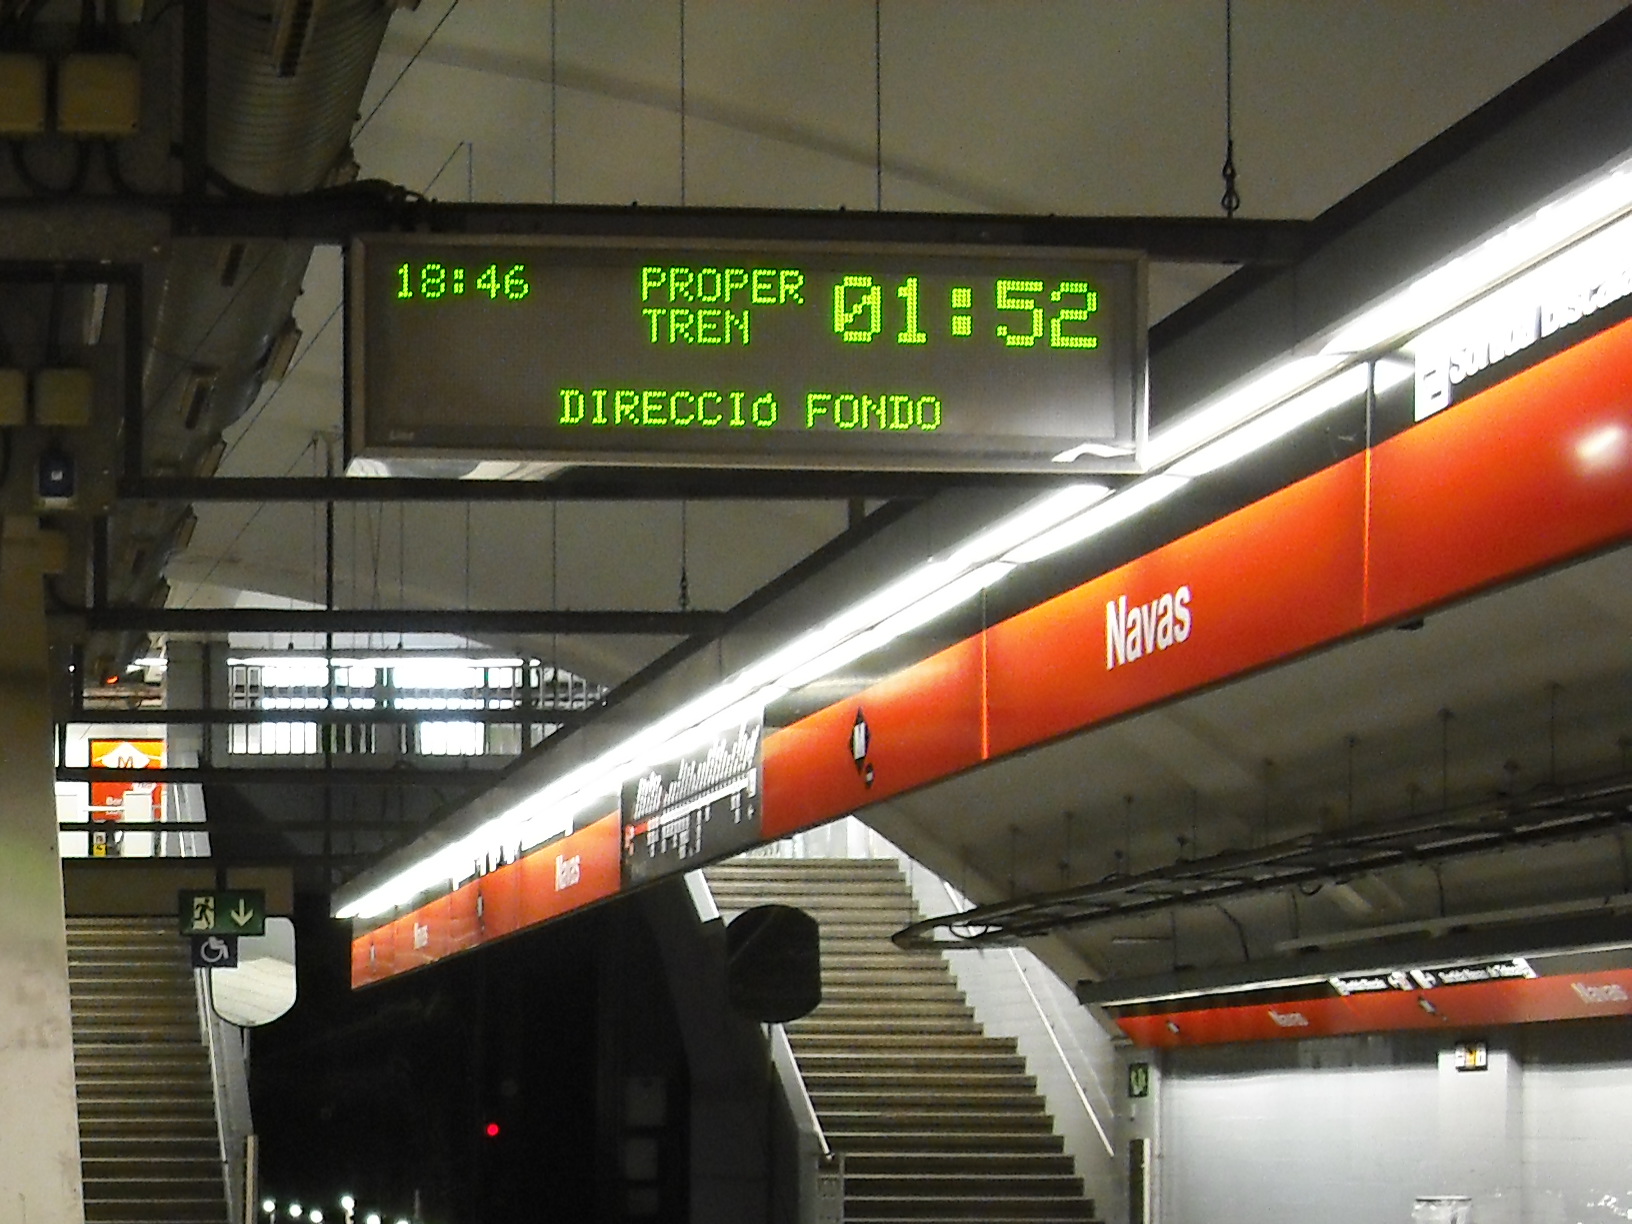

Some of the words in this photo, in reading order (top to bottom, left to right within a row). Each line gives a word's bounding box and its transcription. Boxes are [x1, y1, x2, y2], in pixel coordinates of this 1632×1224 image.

[398, 263, 528, 299] 18:46
[642, 266, 804, 304] PROPER
[642, 307, 750, 345] TREN
[832, 275, 1097, 349] 01:52
[805, 392, 942, 431] FONDO
[1106, 586, 1192, 671] Navas
